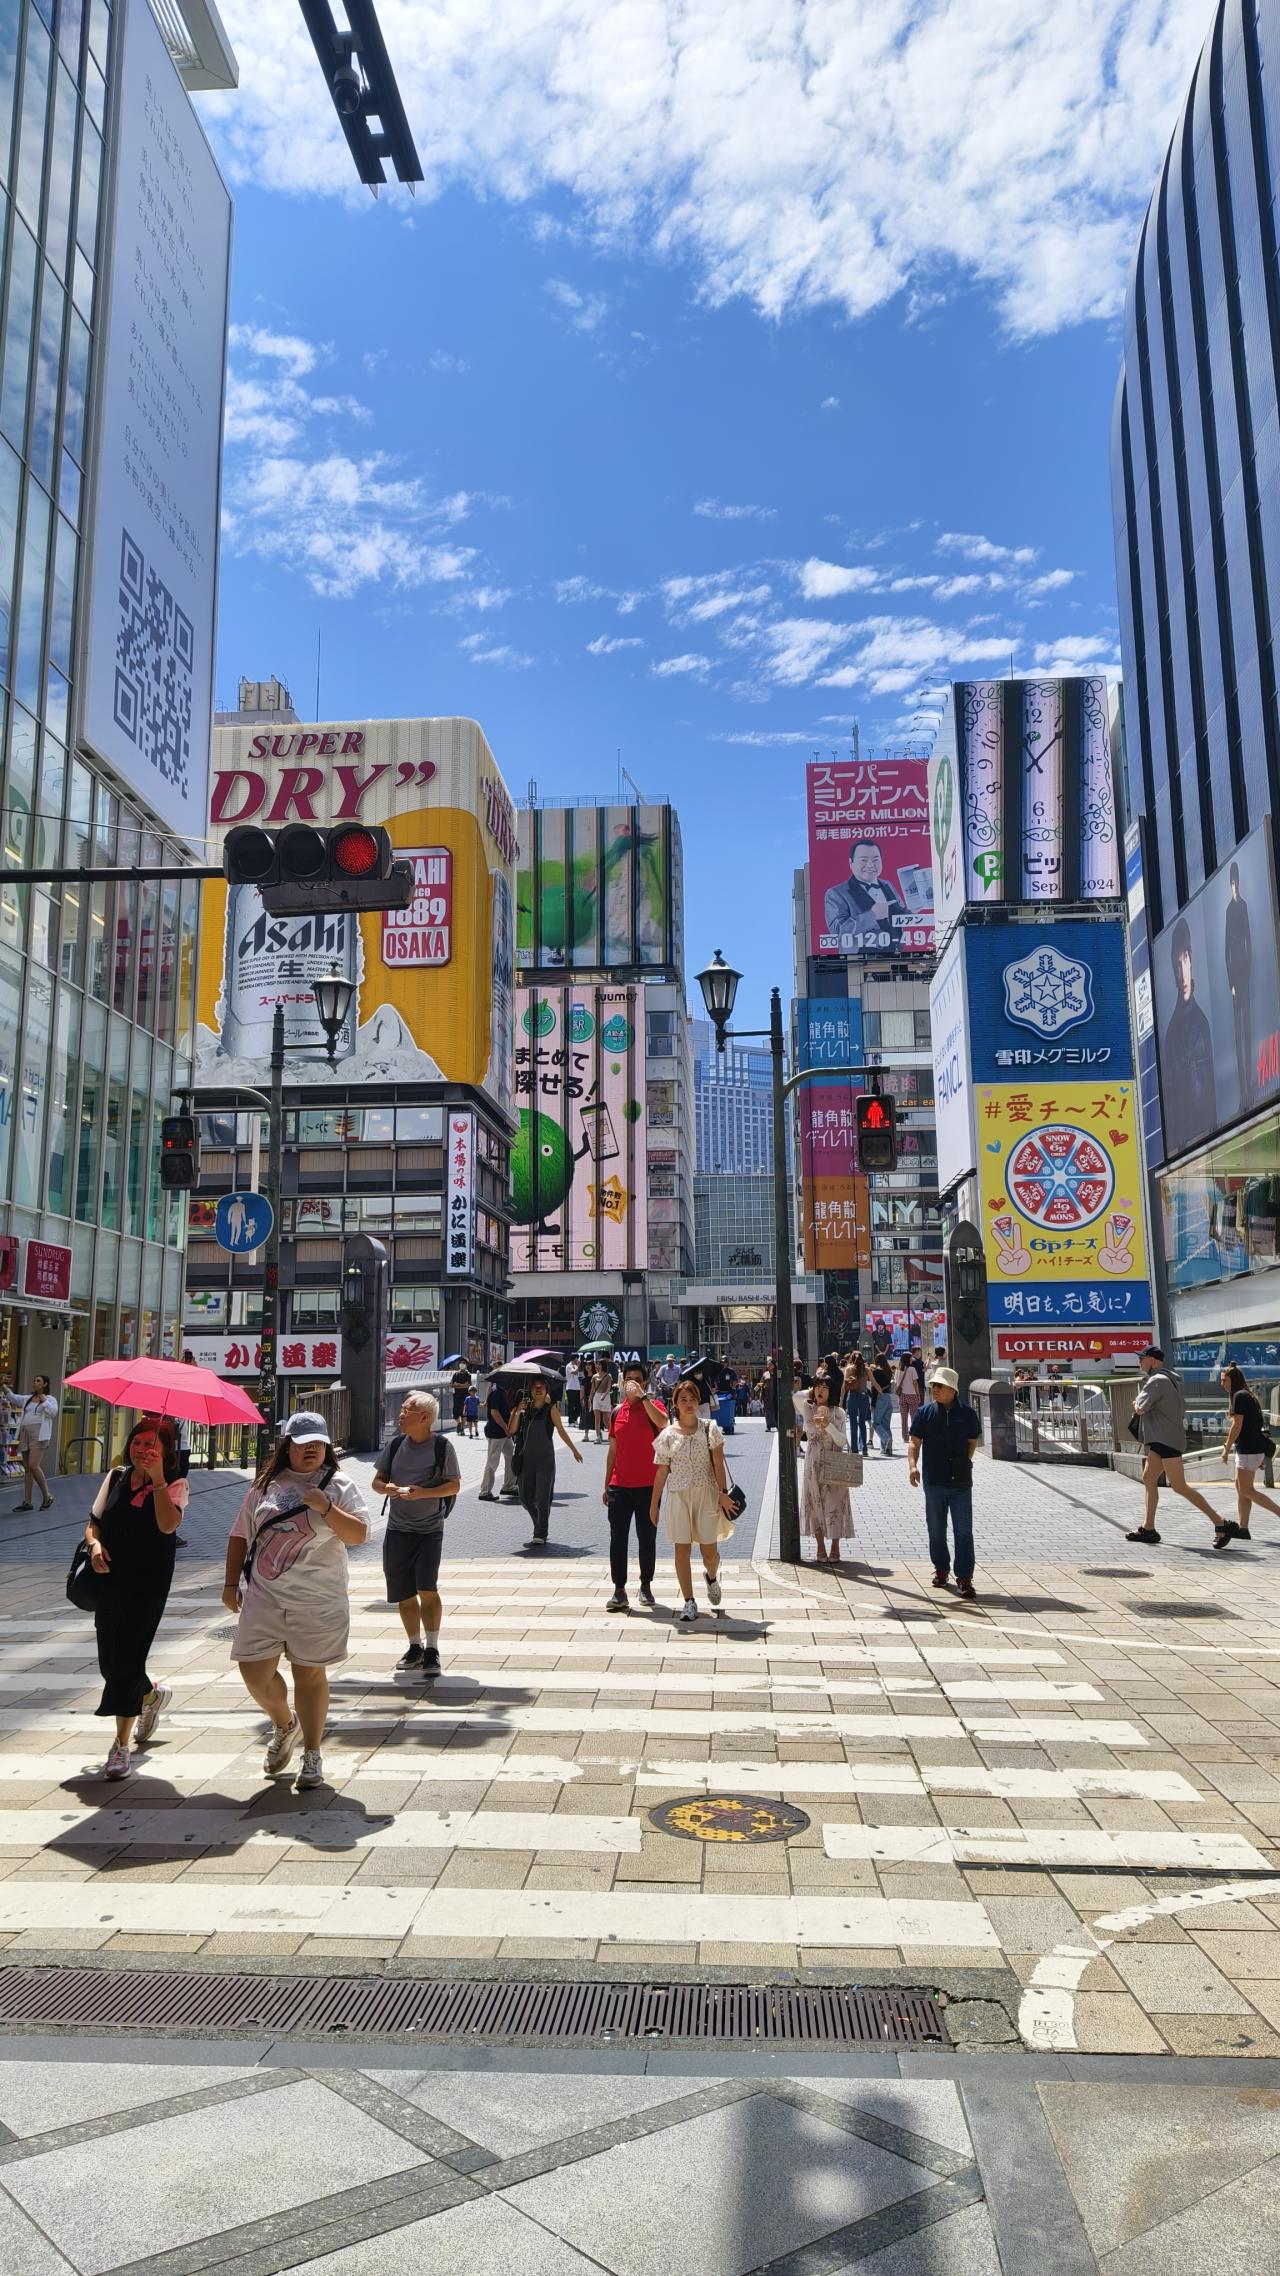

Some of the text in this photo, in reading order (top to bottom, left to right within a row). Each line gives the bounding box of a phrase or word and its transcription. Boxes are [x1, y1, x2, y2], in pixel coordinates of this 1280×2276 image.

[1024, 708, 1043, 724] 12
[248, 731, 364, 758] SUPER
[981, 730, 1001, 751] 10
[814, 764, 899, 786] スーパー
[814, 785, 929, 807] ミリオンヘ
[815, 807, 928, 823] SUPER MILLION
[1032, 800, 1045, 817] 6
[414, 858, 447, 885] AHI
[1080, 878, 1115, 891] 2024
[895, 915, 923, 925] ルアン
[238, 911, 346, 960] Asahi
[385, 931, 446, 959] OSAKA
[277, 960, 305, 978] 生
[258, 993, 318, 1006] スーパードラ
[809, 1021, 849, 1039] 龍角散
[515, 1047, 590, 1071] まとめて
[995, 1047, 1111, 1065] 雪印メグミルク
[515, 1070, 600, 1102] 探せる!
[811, 1109, 853, 1128] 龍角散
[1046, 1134, 1070, 1142] SNOW
[1017, 1146, 1032, 1169] SNOW
[1085, 1146, 1103, 1168] SNOW
[814, 1200, 856, 1219] 龍角散
[34, 1245, 65, 1261] SUNDRUG
[525, 1244, 564, 1258] スーモ
[1003, 1291, 1132, 1316] 明日を、元気に!
[1005, 1339, 1085, 1352] LOTTERIA
